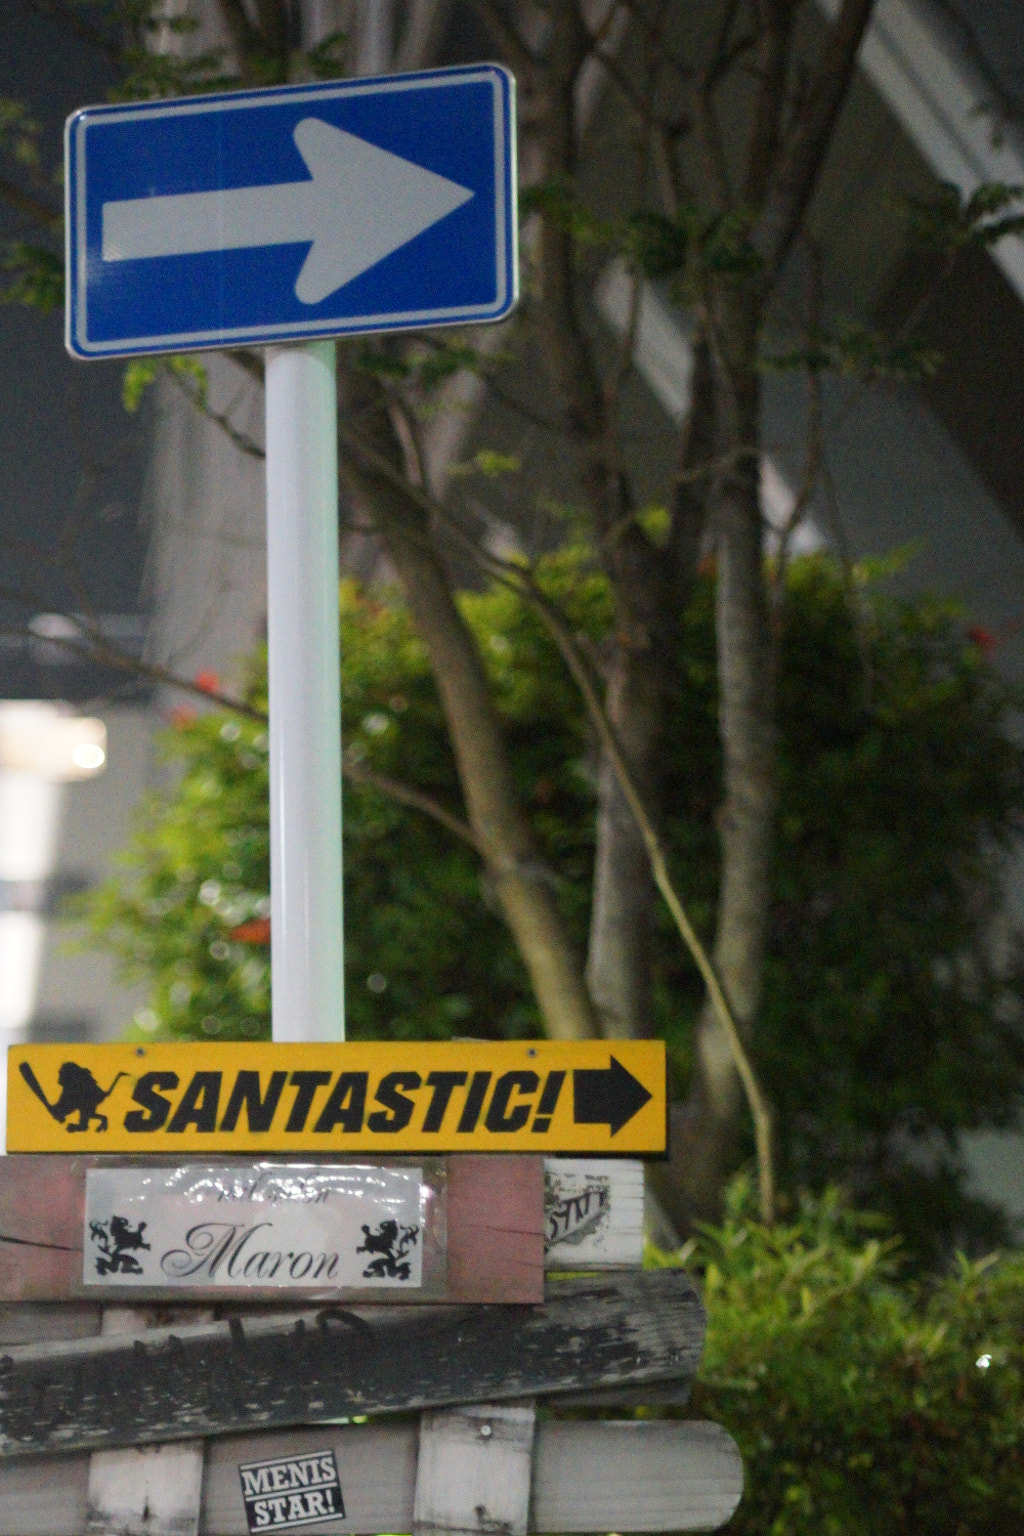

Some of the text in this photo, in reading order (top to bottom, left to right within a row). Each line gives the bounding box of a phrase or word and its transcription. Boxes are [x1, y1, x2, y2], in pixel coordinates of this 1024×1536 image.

[123, 1069, 566, 1134] SANTASTIC!
[160, 1222, 340, 1280] Maron
[241, 1456, 337, 1496] MENIS
[253, 1489, 336, 1526] STAR!
